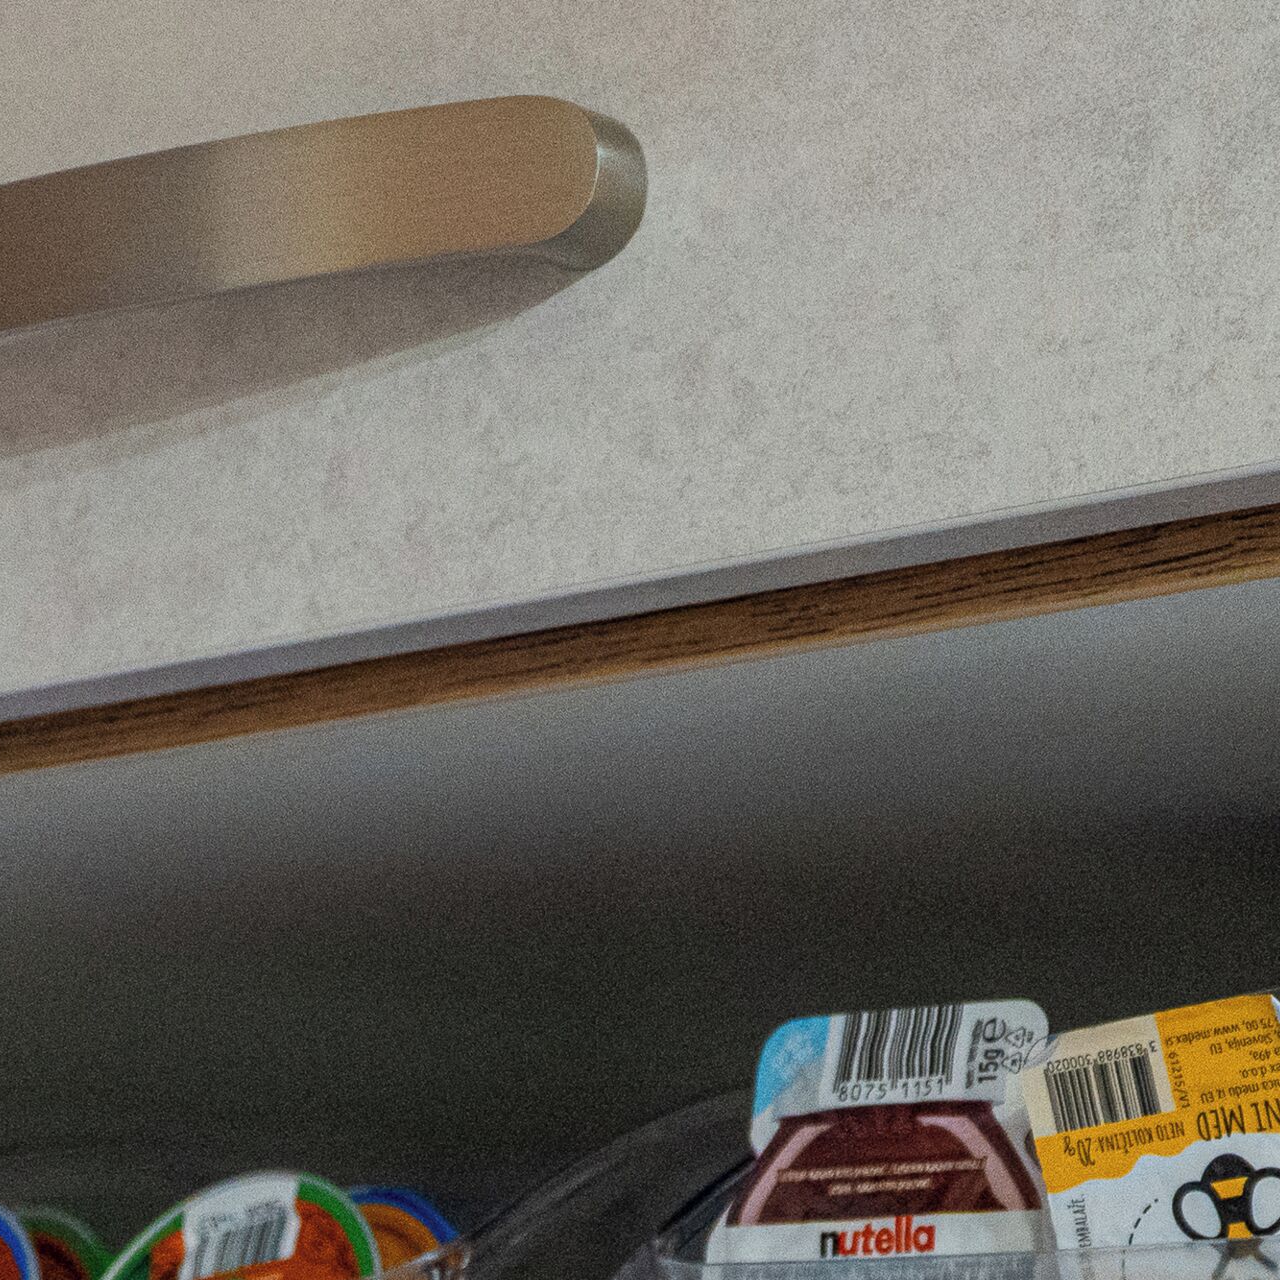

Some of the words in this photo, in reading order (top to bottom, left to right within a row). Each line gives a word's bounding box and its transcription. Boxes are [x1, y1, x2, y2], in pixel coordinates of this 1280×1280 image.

[1148, 1040, 1157, 1052] 3
[837, 1082, 888, 1102] 8075
[900, 1079, 945, 1099] 1151
[1199, 1091, 1214, 1103] EU
[1155, 1120, 1185, 1142] NETO
[1196, 1106, 1246, 1142] MED
[820, 1214, 936, 1259] nutella
